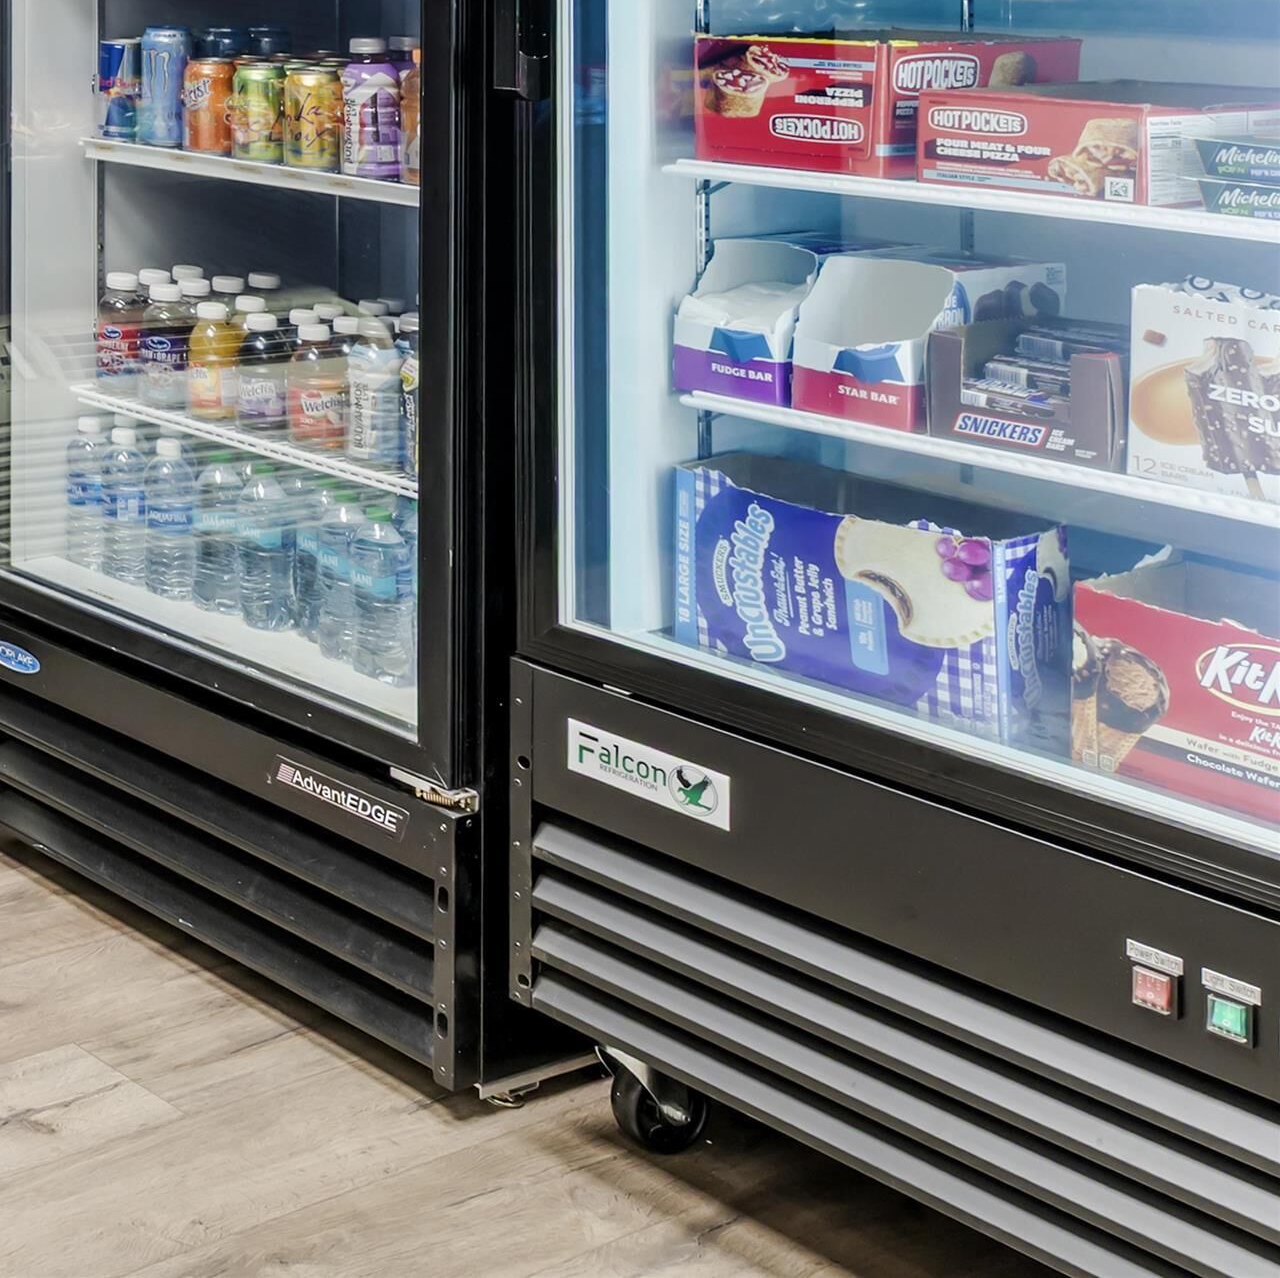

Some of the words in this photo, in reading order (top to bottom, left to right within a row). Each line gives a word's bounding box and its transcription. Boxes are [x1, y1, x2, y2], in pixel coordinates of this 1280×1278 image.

[897, 62, 923, 89] HOT
[922, 58, 976, 89] POCKETS
[795, 95, 864, 108] PEPPERONI
[826, 87, 864, 98] PIZZA
[775, 117, 832, 139] POCKETS
[832, 121, 860, 140] HOT
[932, 109, 961, 128] HOT
[961, 110, 1023, 133] POCKETS
[936, 137, 969, 148] FOUR
[970, 140, 1007, 152] MEAT
[1017, 145, 1051, 156] FOUR
[936, 146, 981, 159] CHEESE
[982, 150, 1020, 162] PIZZA
[1172, 304, 1239, 326] SALTED
[711, 363, 747, 380] FUDGE
[748, 369, 774, 383] BAR
[837, 384, 869, 400] STAR
[869, 391, 899, 406] BAR
[957, 414, 1046, 445] SNICKERS
[1133, 454, 1158, 474] 12
[679, 521, 690, 554] SIZE
[679, 555, 691, 604] LARGE
[793, 556, 806, 593] Butter
[806, 562, 821, 588] Jelly
[795, 594, 811, 636] Peanut
[809, 590, 824, 626] Grape
[820, 577, 838, 631] Sandwich
[578, 731, 668, 788] Falcon
[1185, 753, 1244, 779] Chocolate
[1186, 737, 1220, 754] Wafer
[1243, 754, 1280, 773] Fudge
[599, 763, 659, 792] REFRIGERATION
[291, 769, 399, 829] AdvantEDGE
[1129, 941, 1154, 960] Power
[1153, 952, 1180, 970] Switch
[1205, 972, 1225, 989] Light
[1228, 981, 1257, 998] Switch
